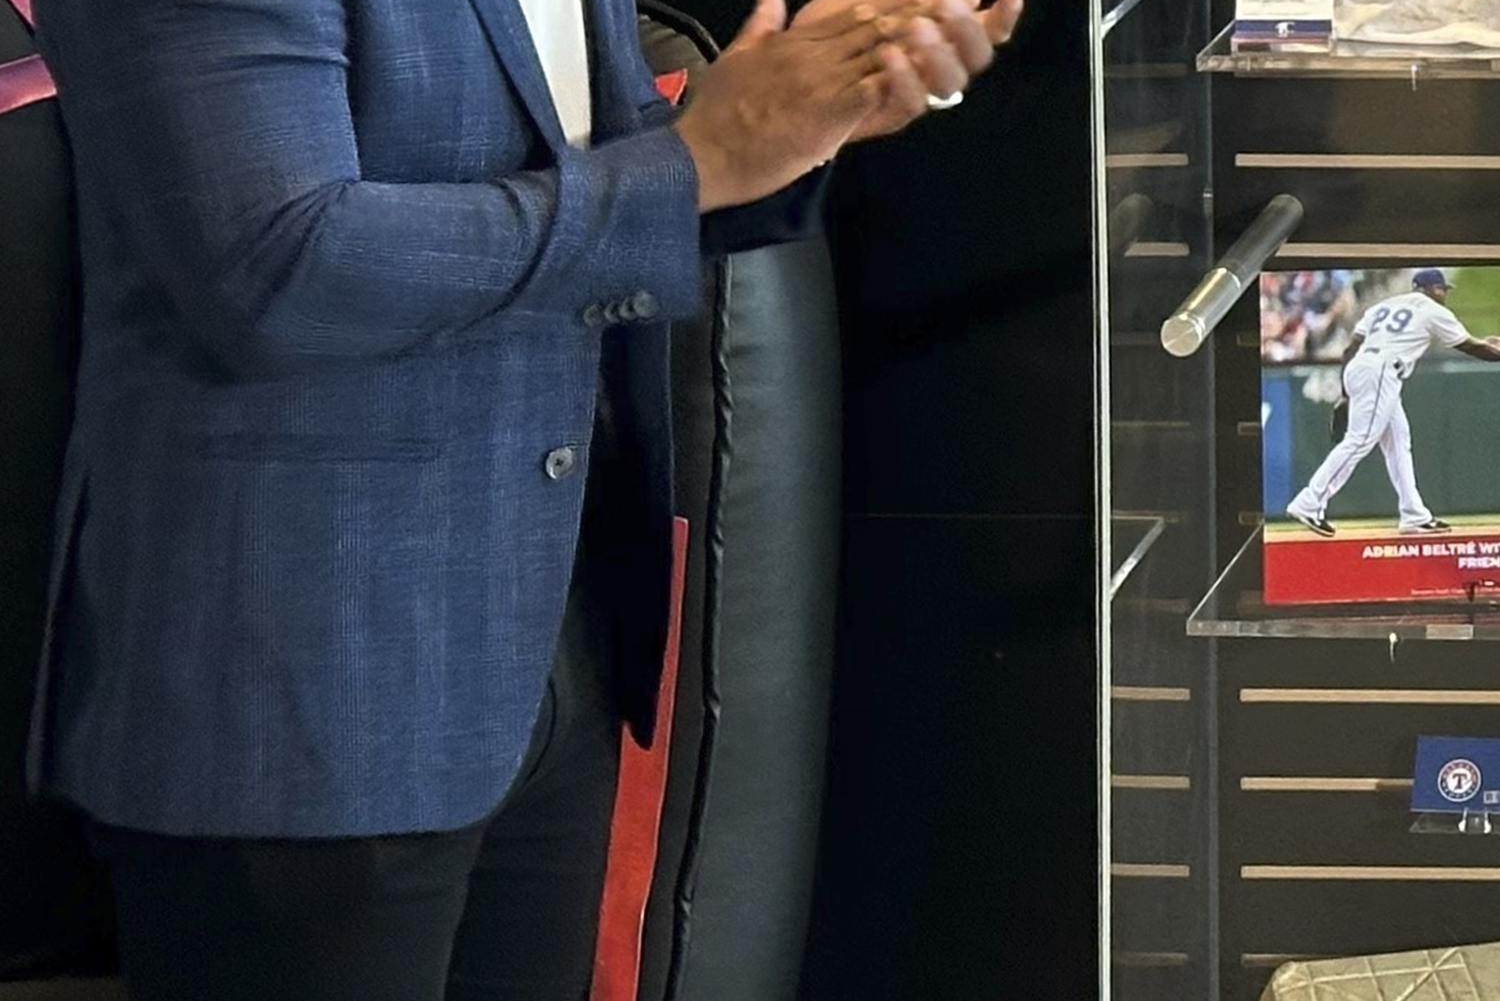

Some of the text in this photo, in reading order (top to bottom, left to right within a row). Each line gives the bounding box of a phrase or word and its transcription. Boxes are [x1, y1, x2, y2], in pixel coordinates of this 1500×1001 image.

[1370, 309, 1413, 334] 29
[1363, 545, 1419, 558] ADRIAN
[1422, 541, 1476, 556] BELTRÉ
